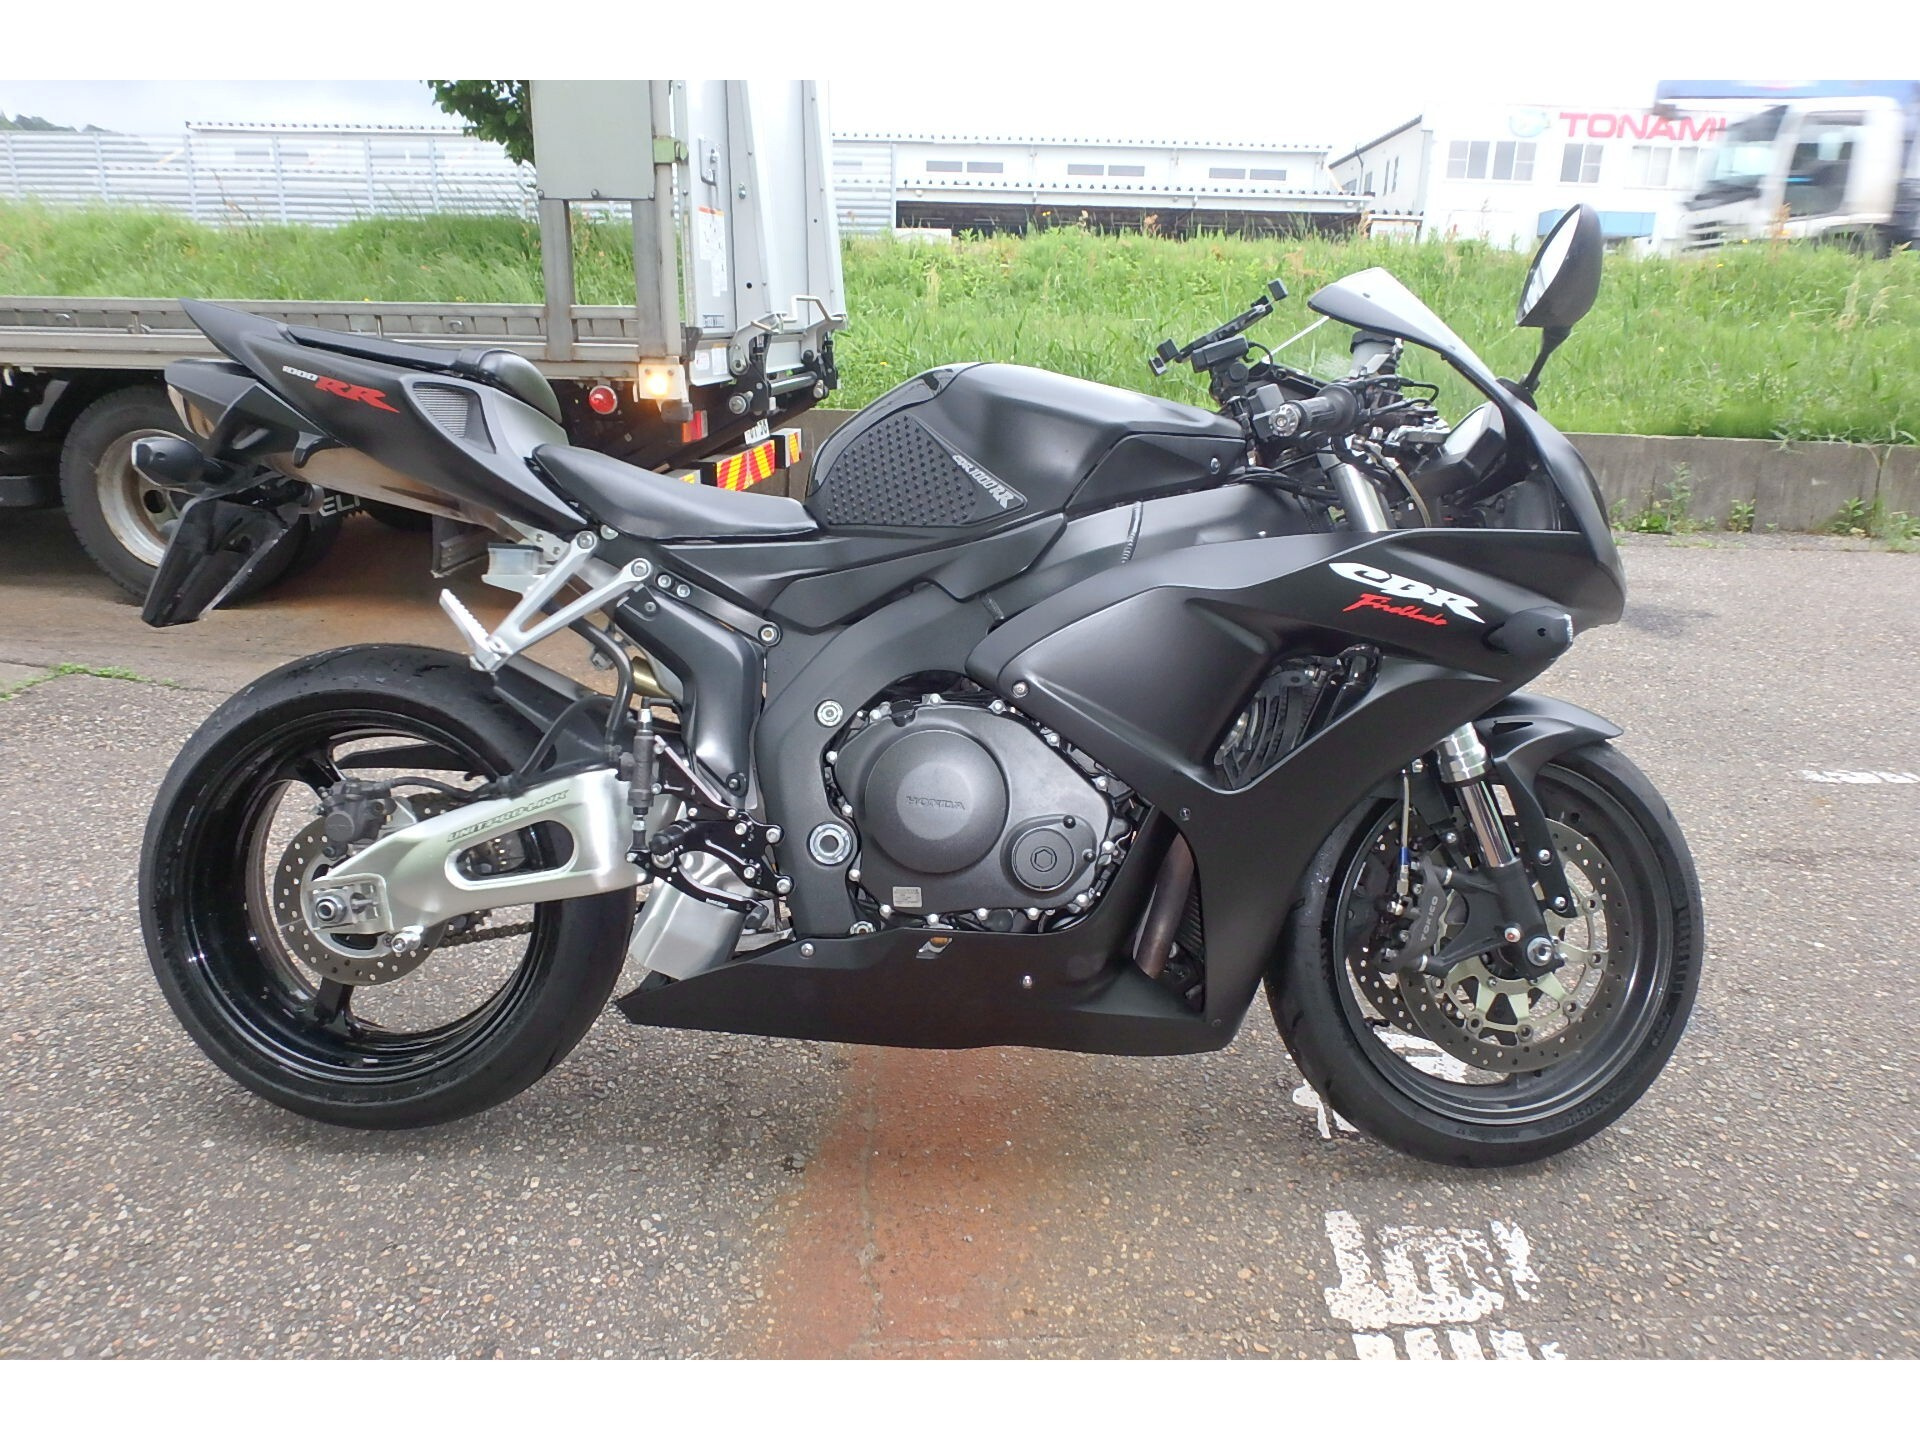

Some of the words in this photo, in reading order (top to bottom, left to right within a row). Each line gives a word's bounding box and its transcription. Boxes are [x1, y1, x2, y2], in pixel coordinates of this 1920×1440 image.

[952, 454, 1014, 509] CBR1000RR
[1328, 562, 1486, 624] CBR
[906, 795, 965, 810] HONDA
[1421, 896, 1438, 941] TOKICO
